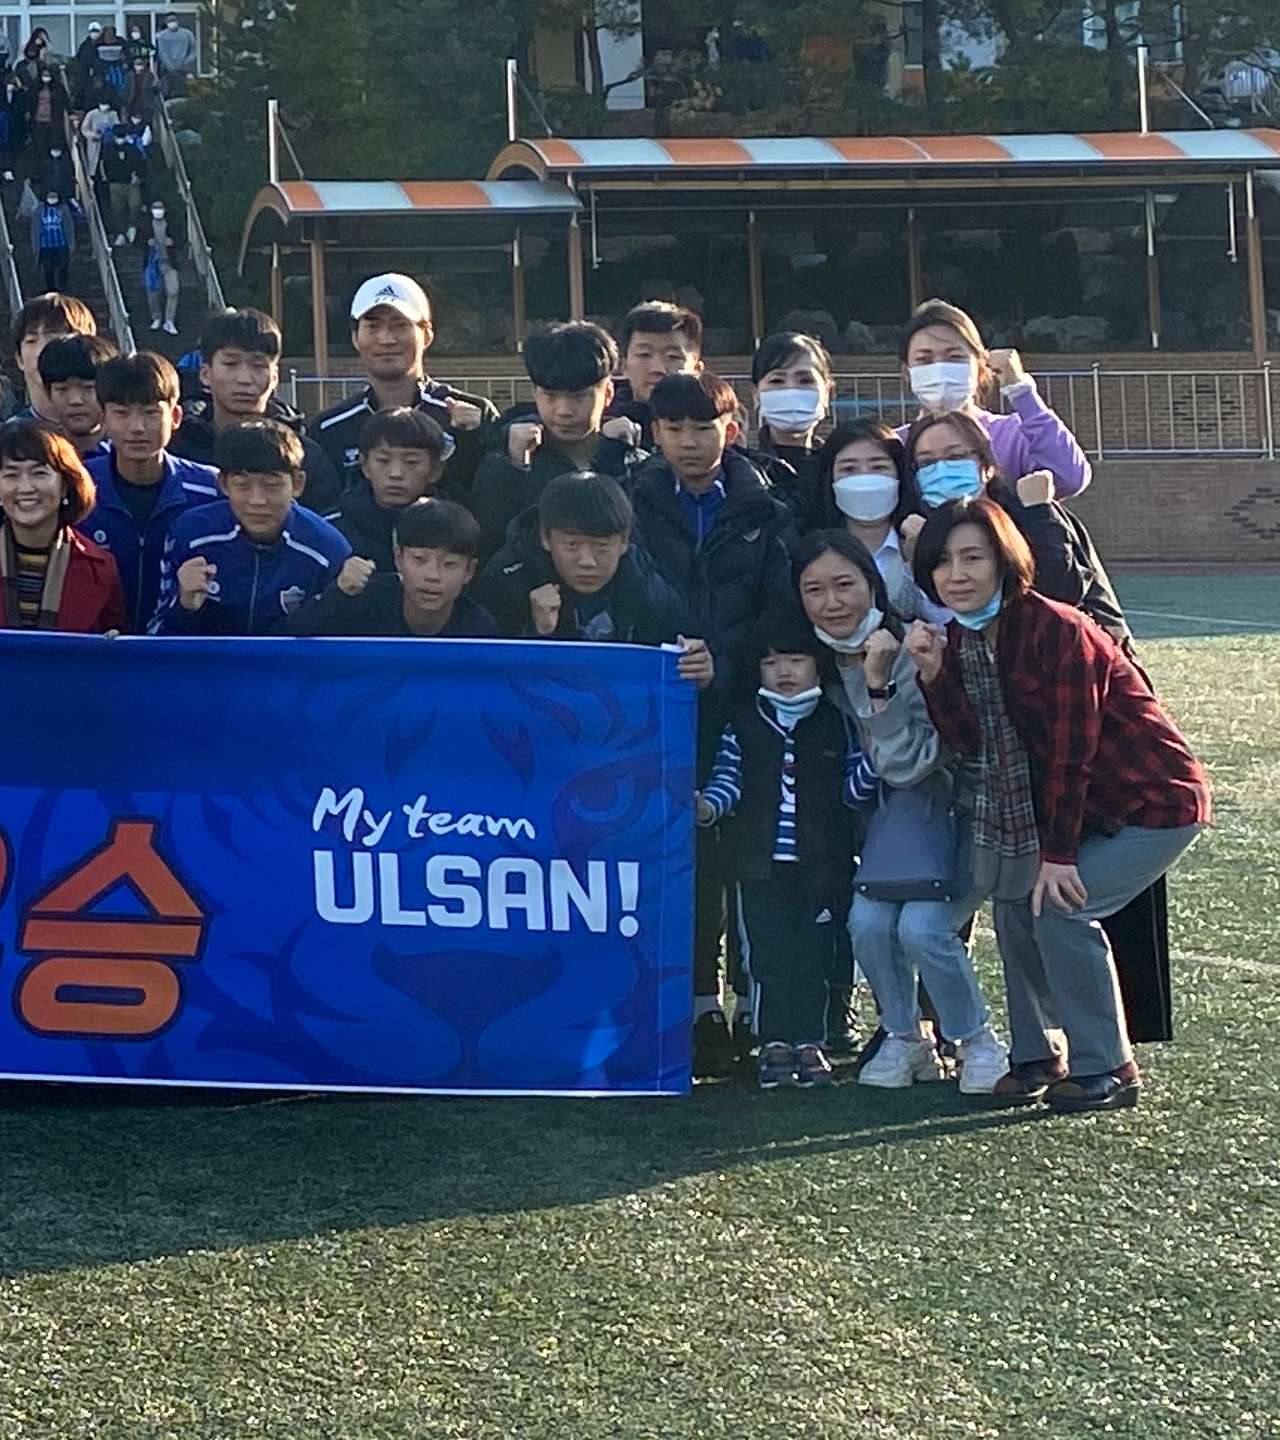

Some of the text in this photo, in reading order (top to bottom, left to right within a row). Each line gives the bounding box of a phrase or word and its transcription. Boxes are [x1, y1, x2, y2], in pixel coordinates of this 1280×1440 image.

[312, 787, 536, 847] My team
[313, 849, 640, 938] ULSAN!
